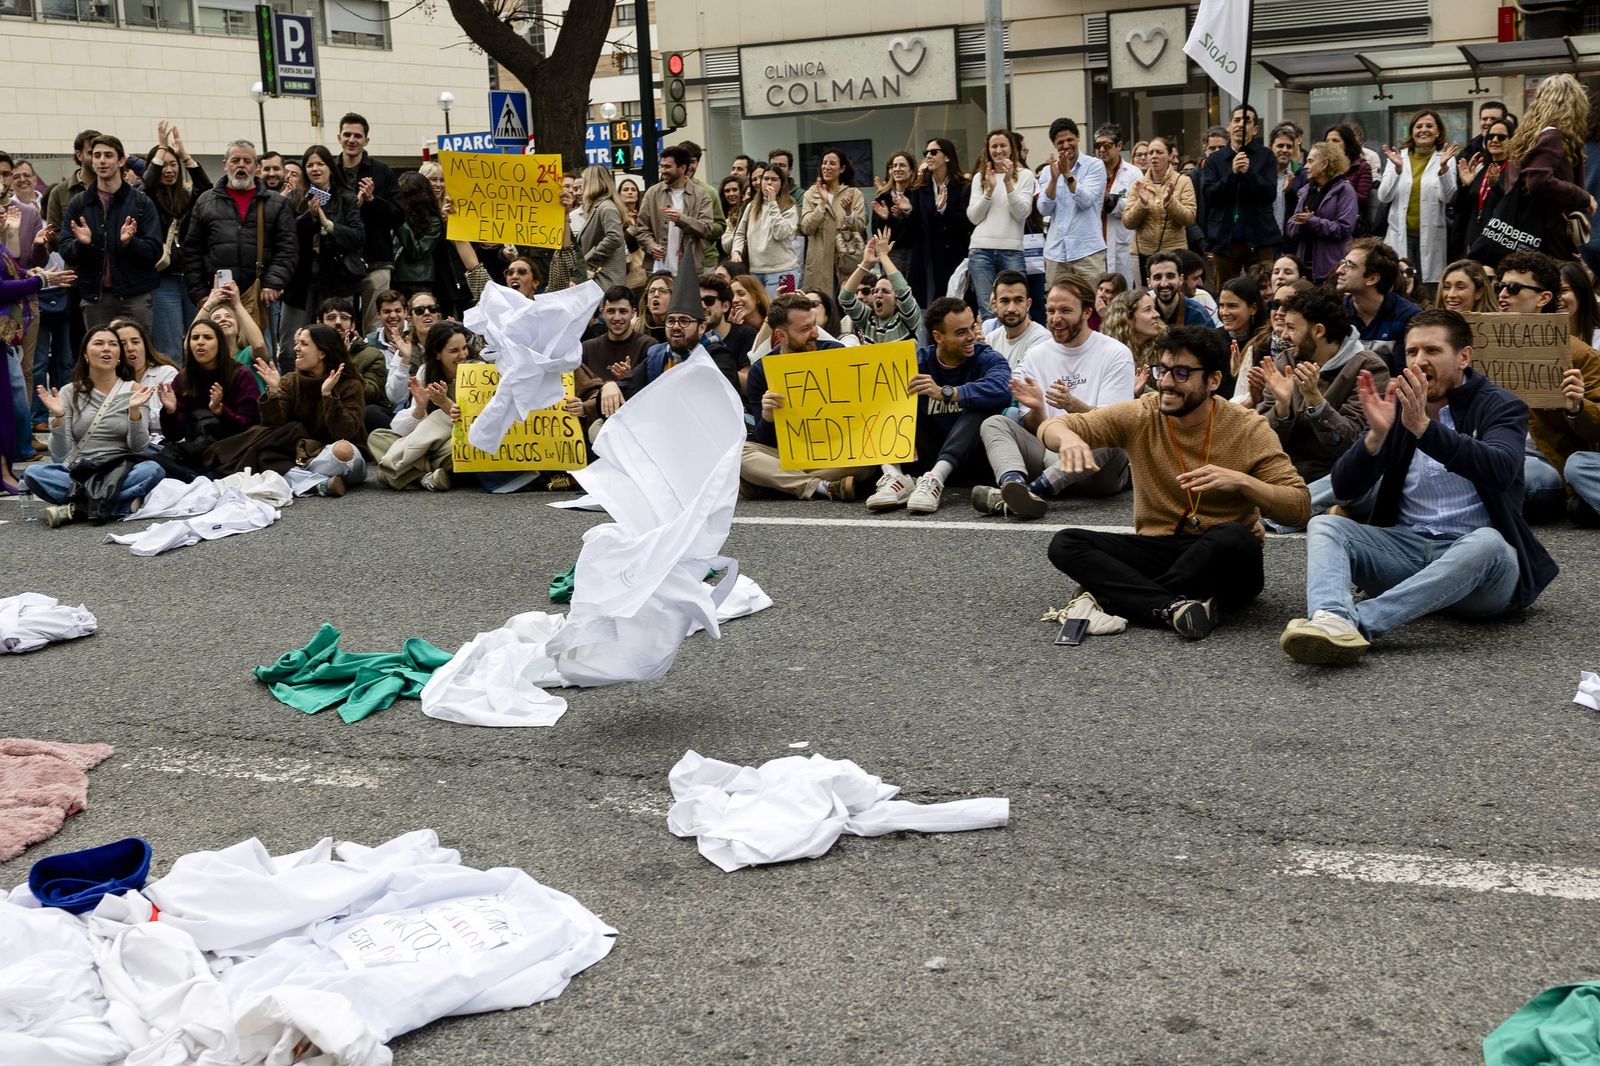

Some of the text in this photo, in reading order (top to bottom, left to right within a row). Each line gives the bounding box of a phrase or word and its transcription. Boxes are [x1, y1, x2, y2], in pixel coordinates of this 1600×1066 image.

[283, 19, 305, 62] P
[764, 60, 826, 80] CLÍNICA
[766, 74, 902, 107] COLMAN
[442, 134, 494, 152] APARC
[616, 122, 629, 140] 16
[450, 155, 526, 182] MÉDICO
[471, 183, 554, 203] AGOTADO
[457, 198, 539, 223] PACIENTE
[479, 220, 563, 246] EN RIESGO
[1492, 320, 1568, 348] VOCACIÓN
[461, 369, 477, 386] NO
[784, 359, 910, 409] FALTAN
[524, 415, 575, 438] HORAS
[453, 444, 471, 460] NO
[554, 439, 585, 465] VANO
